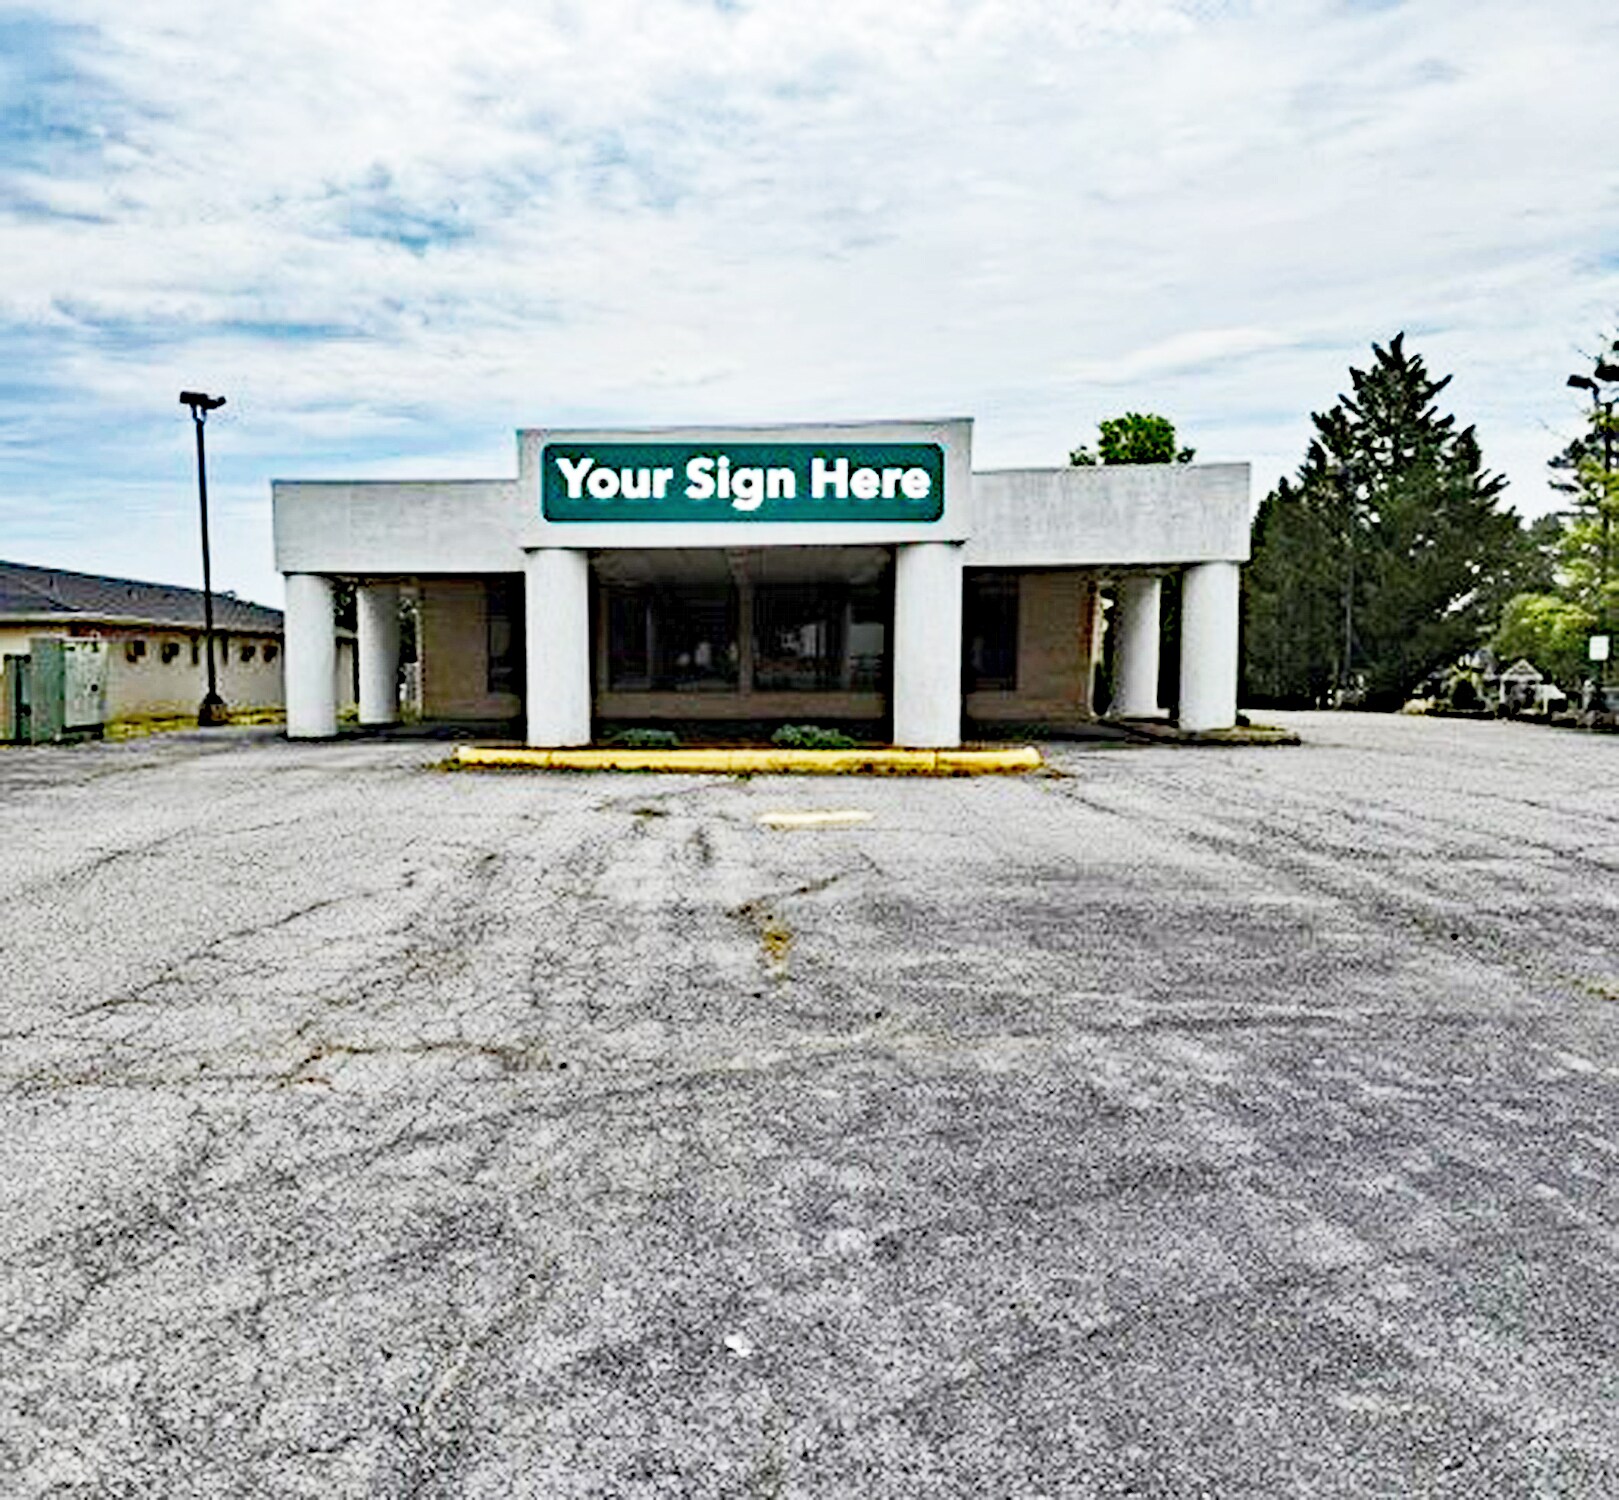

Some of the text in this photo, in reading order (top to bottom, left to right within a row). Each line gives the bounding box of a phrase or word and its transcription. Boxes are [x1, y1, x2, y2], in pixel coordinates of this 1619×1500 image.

[556, 455, 931, 511] Your Sign Here
